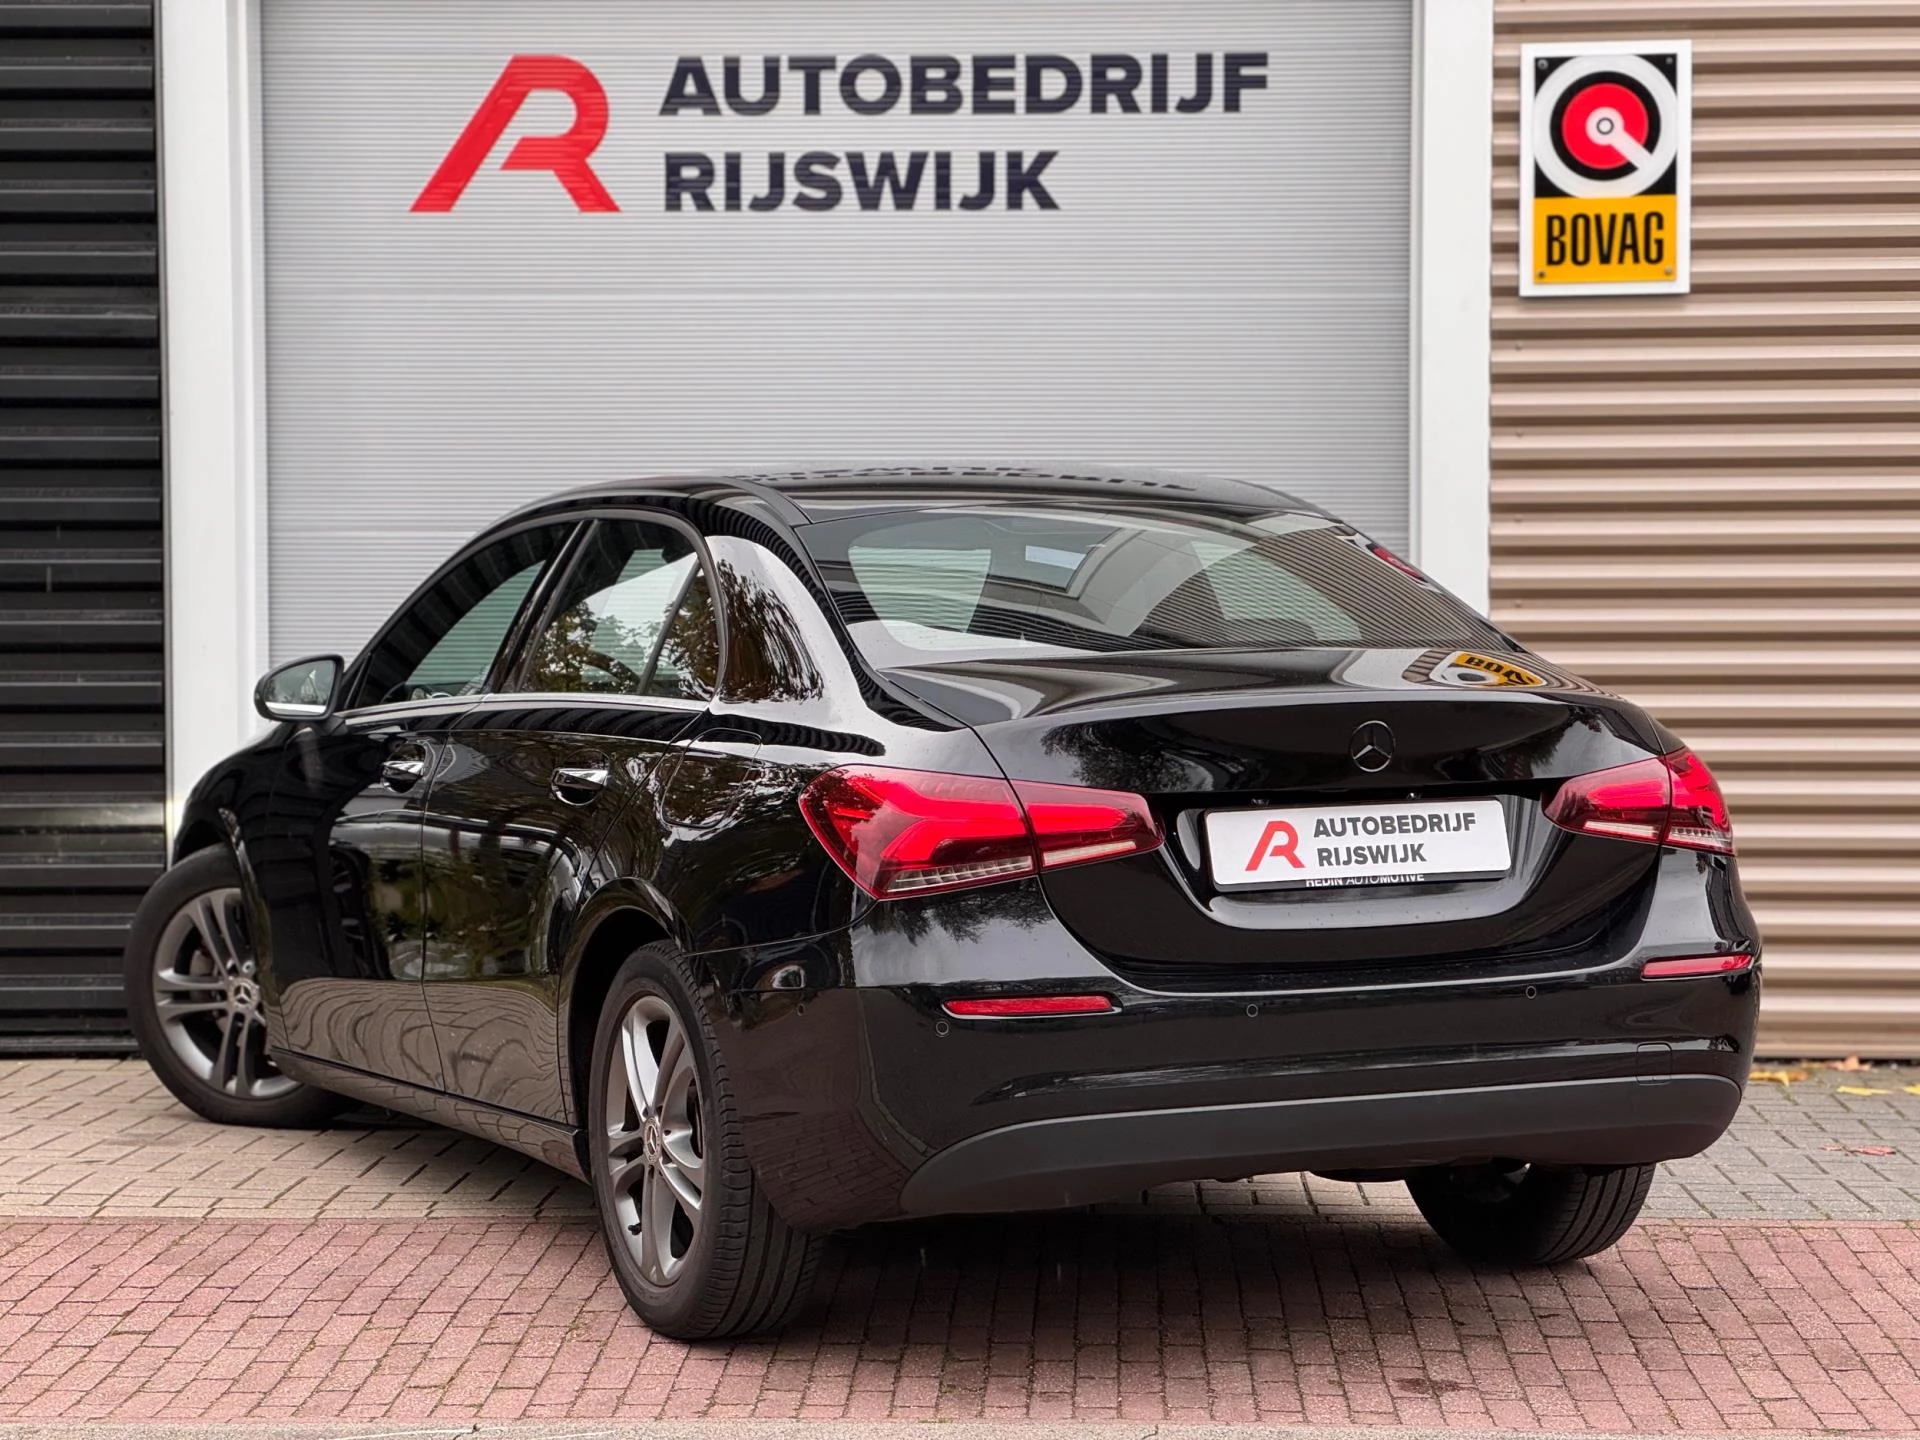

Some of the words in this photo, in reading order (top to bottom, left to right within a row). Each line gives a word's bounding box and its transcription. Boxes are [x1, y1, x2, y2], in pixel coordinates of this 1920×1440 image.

[659, 52, 1269, 116] AUTOBEDRIJF
[665, 151, 1060, 212] RIJSWIJK
[1546, 211, 1664, 266] BOVAG
[1313, 812, 1476, 838] AUTOBEDRIJF
[1316, 843, 1427, 867] RIJSWIJK
